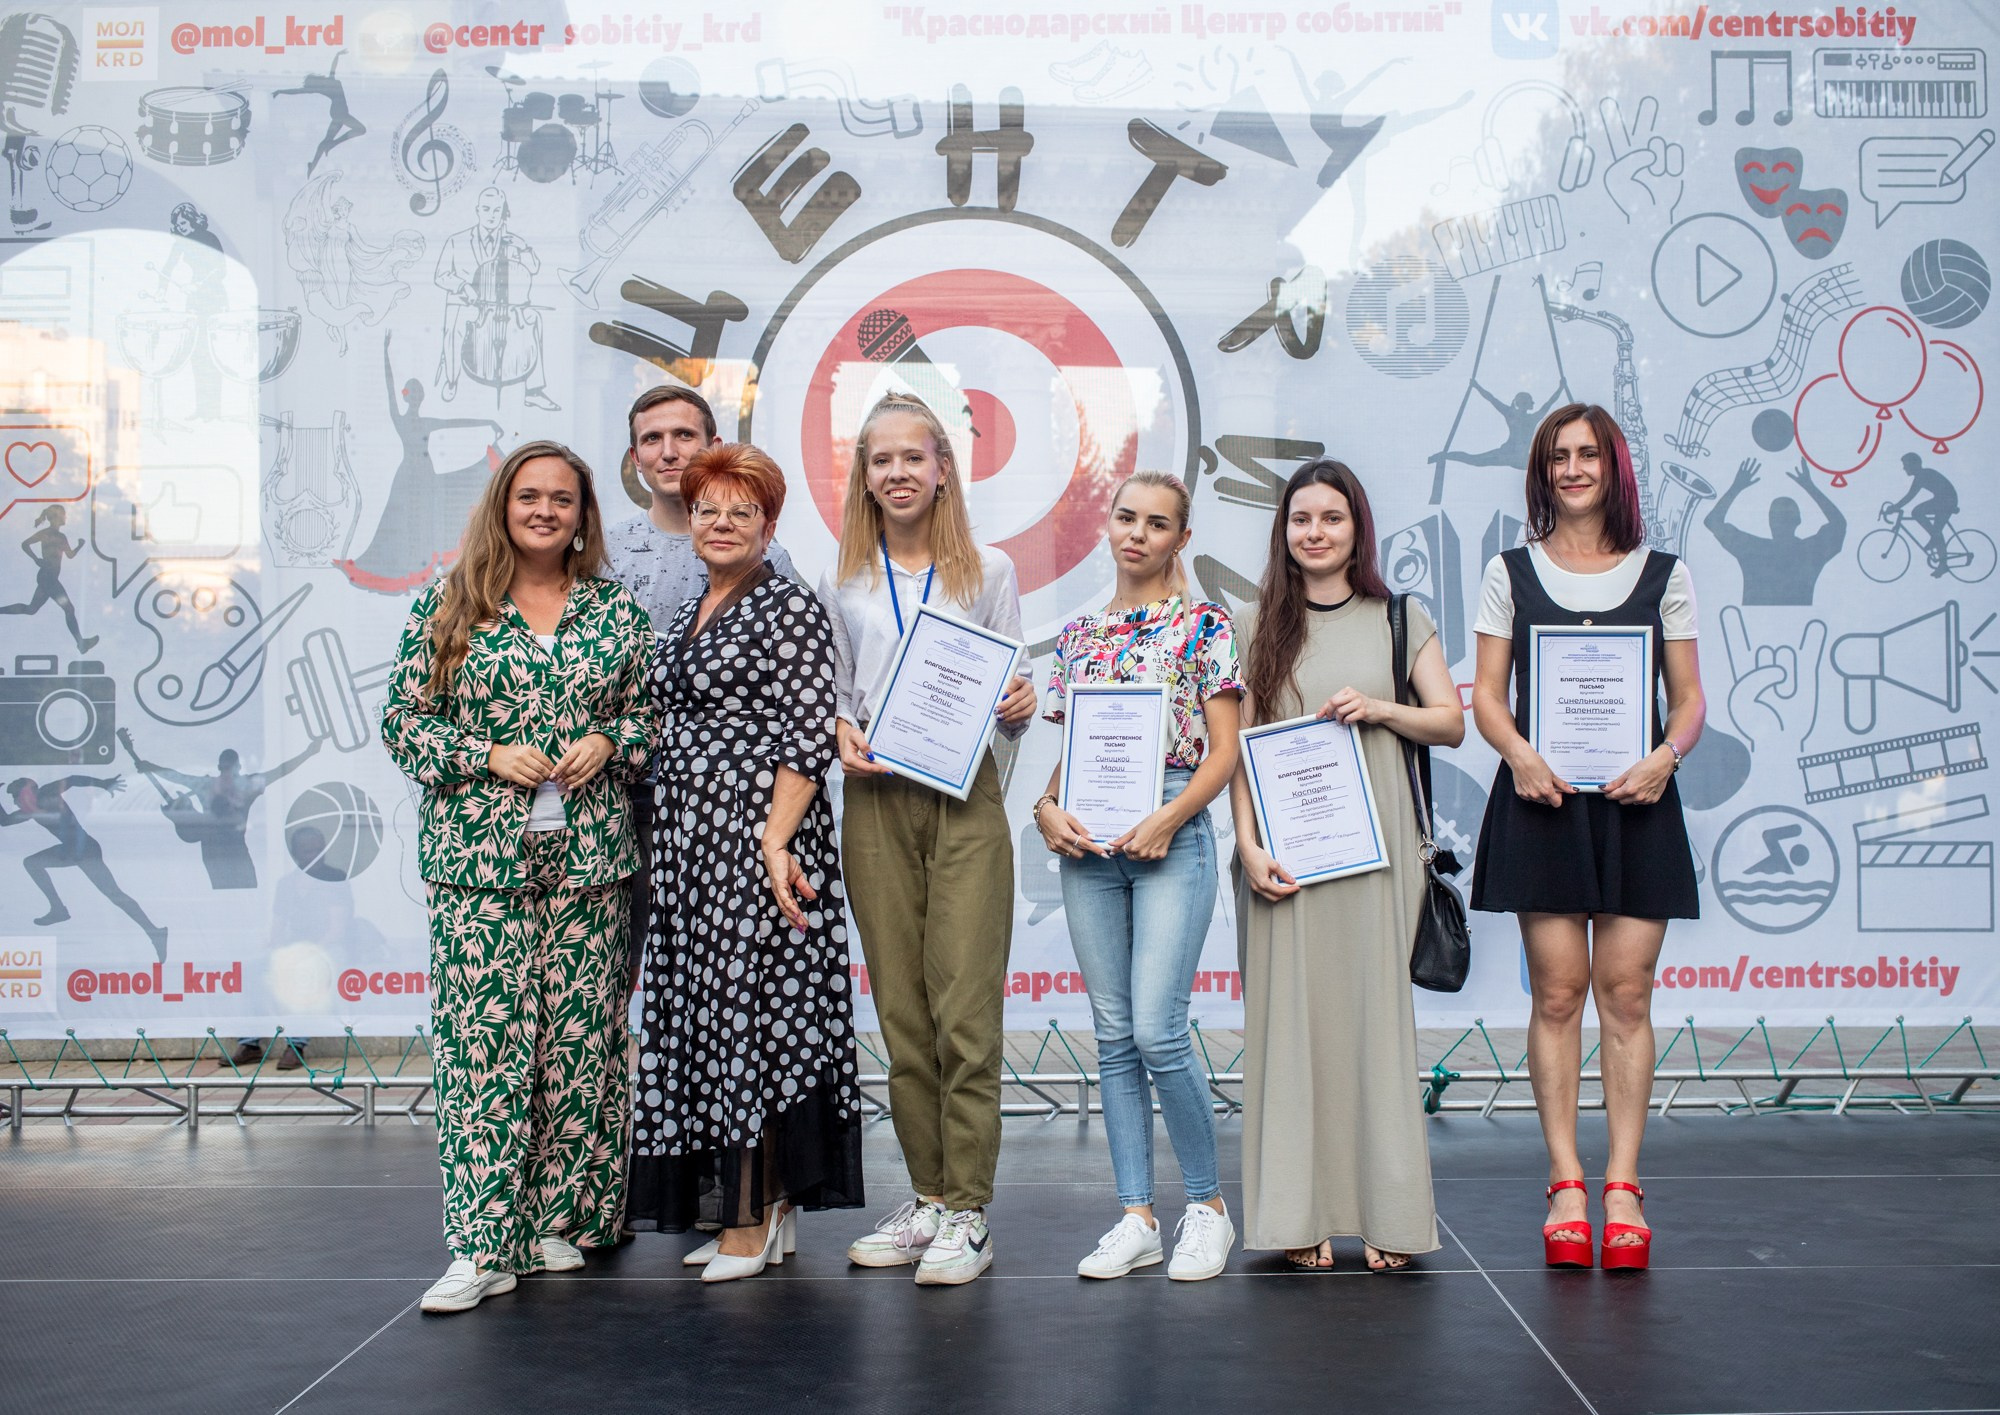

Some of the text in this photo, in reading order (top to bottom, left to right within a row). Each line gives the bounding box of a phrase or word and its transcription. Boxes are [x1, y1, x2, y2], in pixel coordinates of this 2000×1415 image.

[96, 21, 145, 37] МОЛ
[883, 2, 1462, 44] "Краснодарский Центр событий"
[1569, 5, 1917, 45] vk.com/centrsobitiy
[171, 15, 344, 54] @mol_krd
[423, 12, 762, 54] @centr_sobitiy_krd
[96, 52, 145, 67] KRD
[929, 693, 952, 708] Юлии
[1558, 697, 1624, 705] Синельниковой
[1565, 706, 1616, 714] Валентине
[1095, 755, 1130, 763] Синицкой
[1101, 765, 1125, 773] Марии
[1291, 784, 1331, 798] Каспарян
[1301, 794, 1328, 806] Диане
[67, 962, 242, 1002] @mol_krd
[1652, 955, 1960, 996] .com/centrsobitiy
